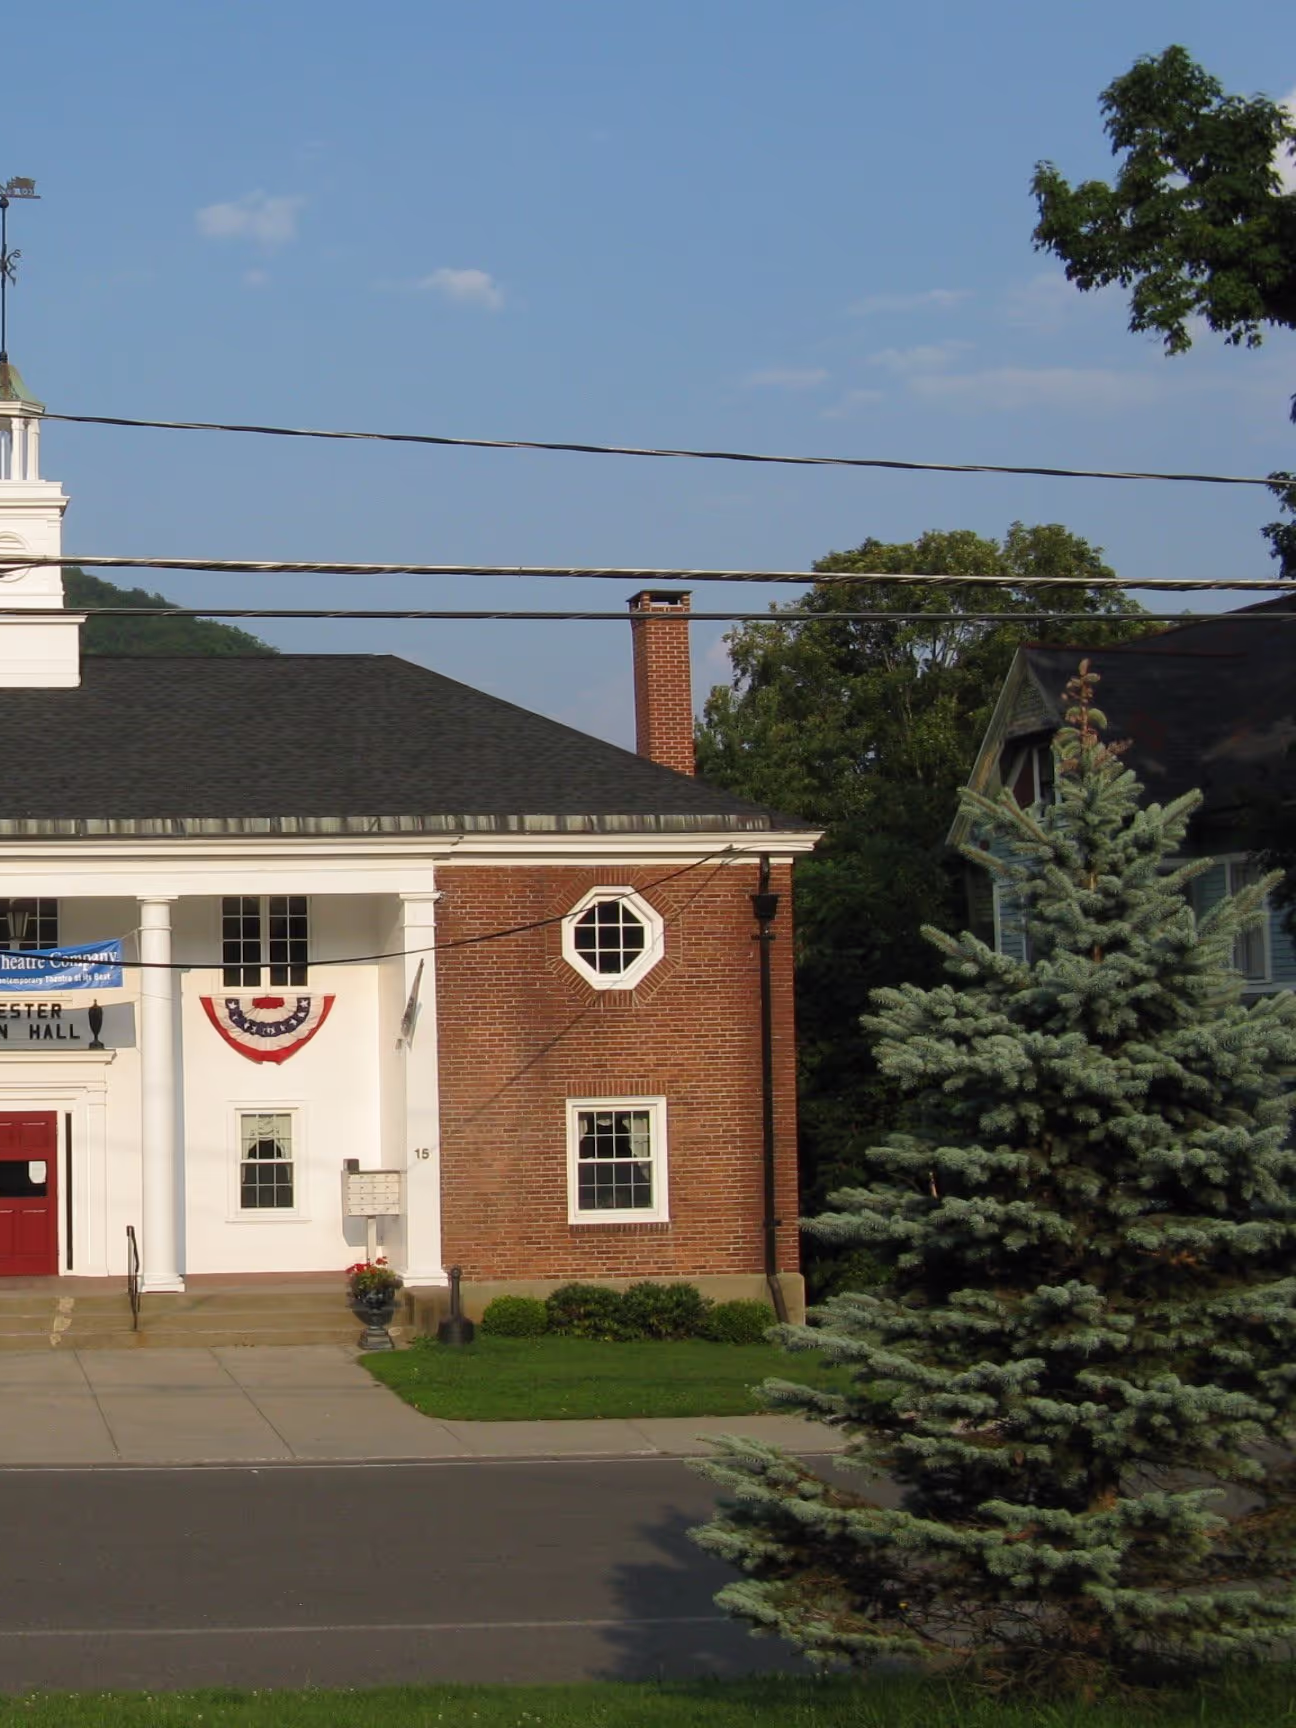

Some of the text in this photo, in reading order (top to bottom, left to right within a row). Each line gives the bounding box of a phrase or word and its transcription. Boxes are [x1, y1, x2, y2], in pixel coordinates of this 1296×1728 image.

[49, 951, 118, 971] Company
[29, 1024, 81, 1040] HALL
[414, 1148, 430, 1159] 15
